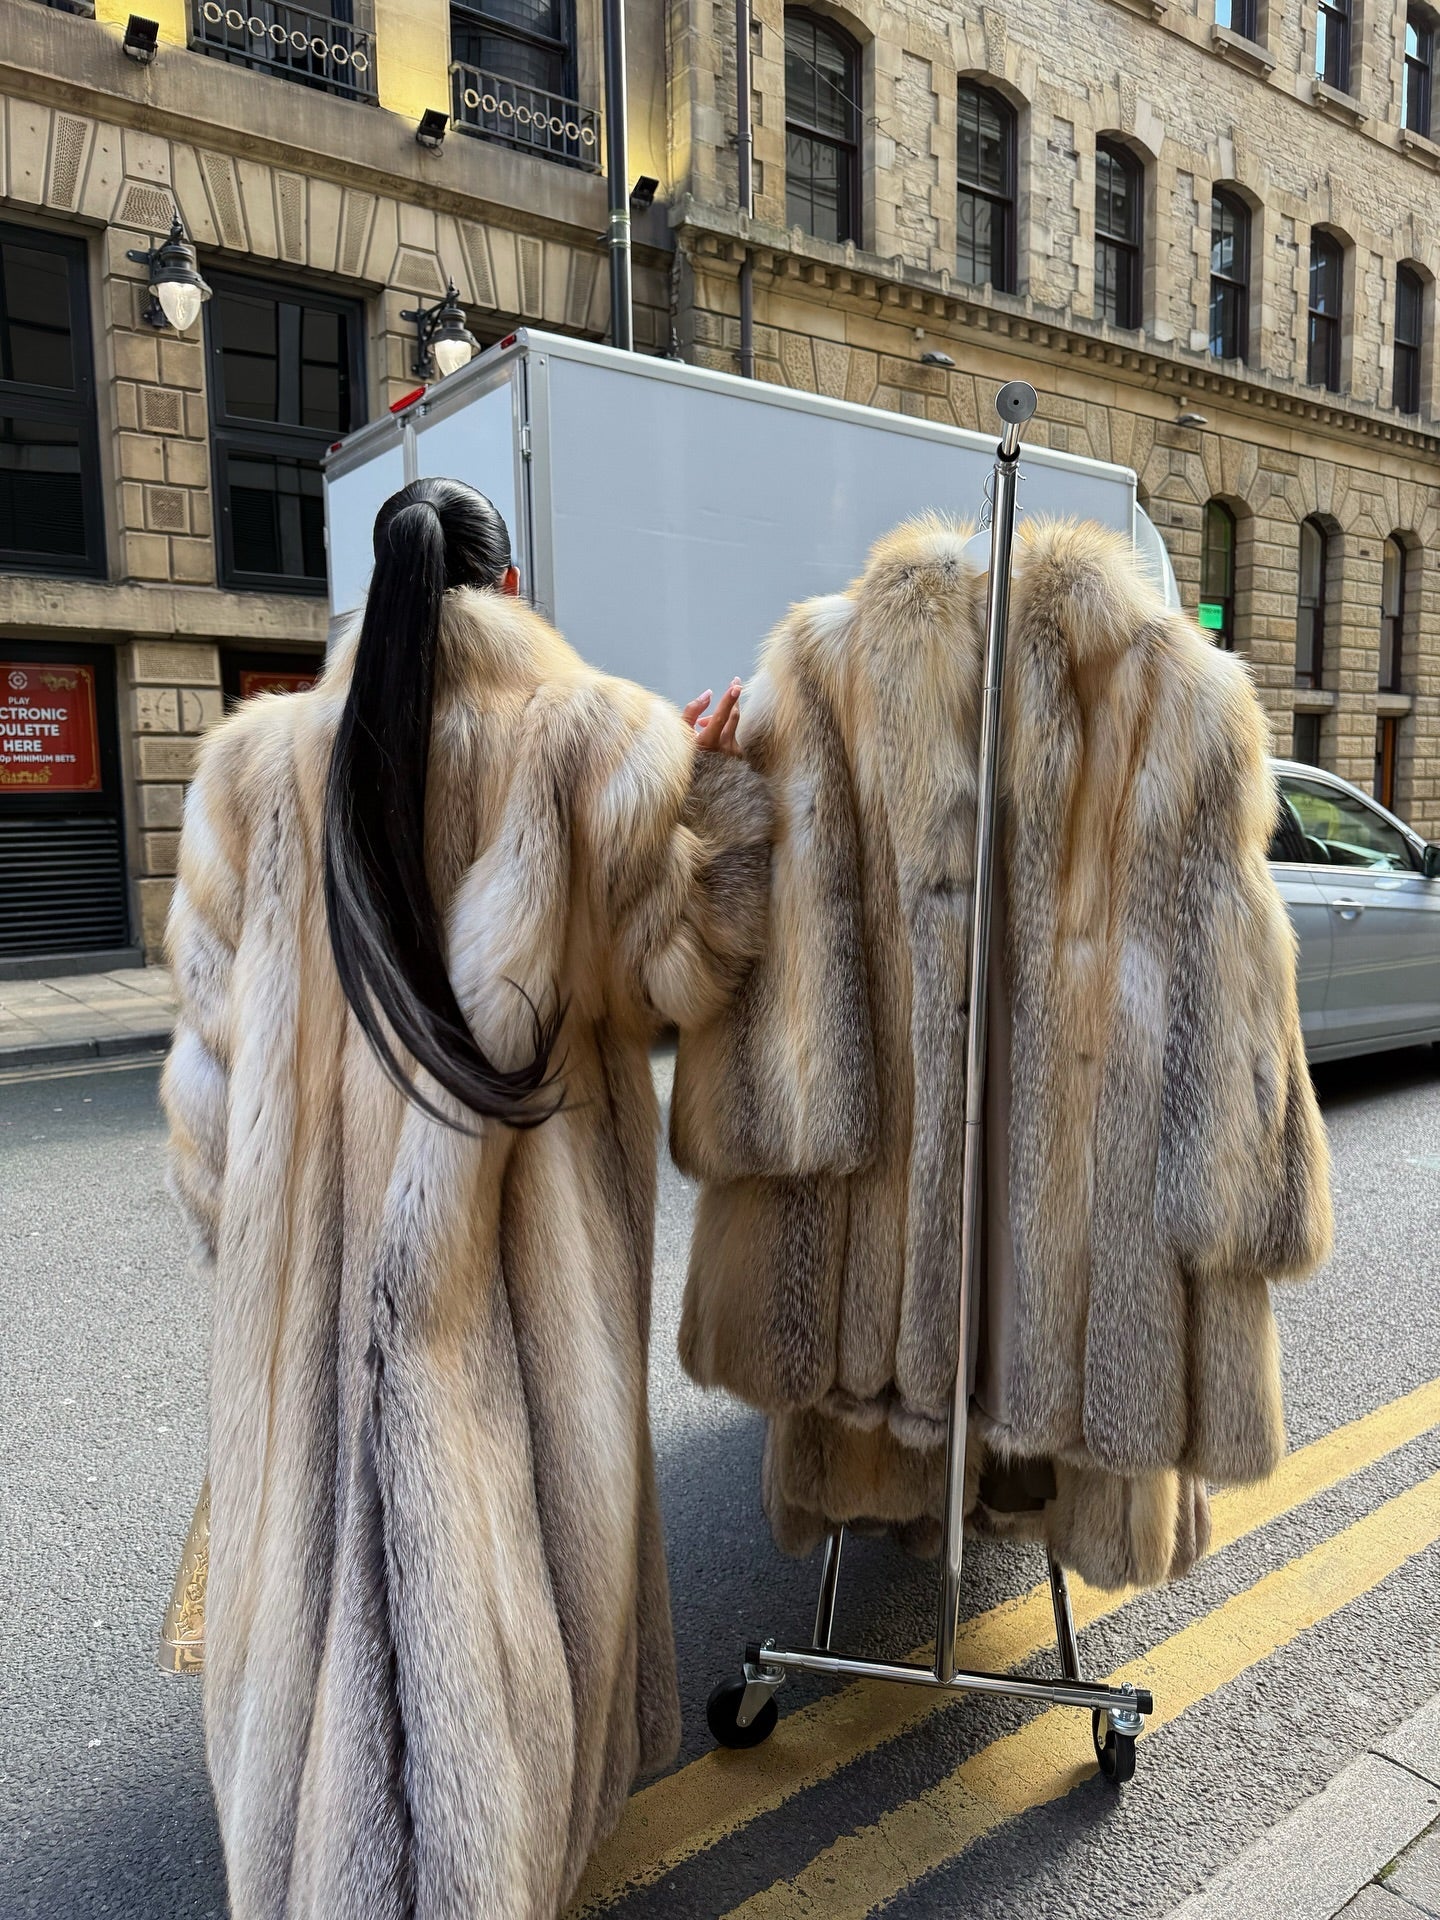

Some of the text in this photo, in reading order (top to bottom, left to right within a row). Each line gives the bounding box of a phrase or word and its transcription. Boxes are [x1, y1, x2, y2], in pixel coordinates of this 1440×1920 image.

[8, 696, 30, 705] PLAY
[0, 707, 68, 720] CTRONIC
[3, 739, 43, 752] HERE
[54, 755, 76, 763] BETS
